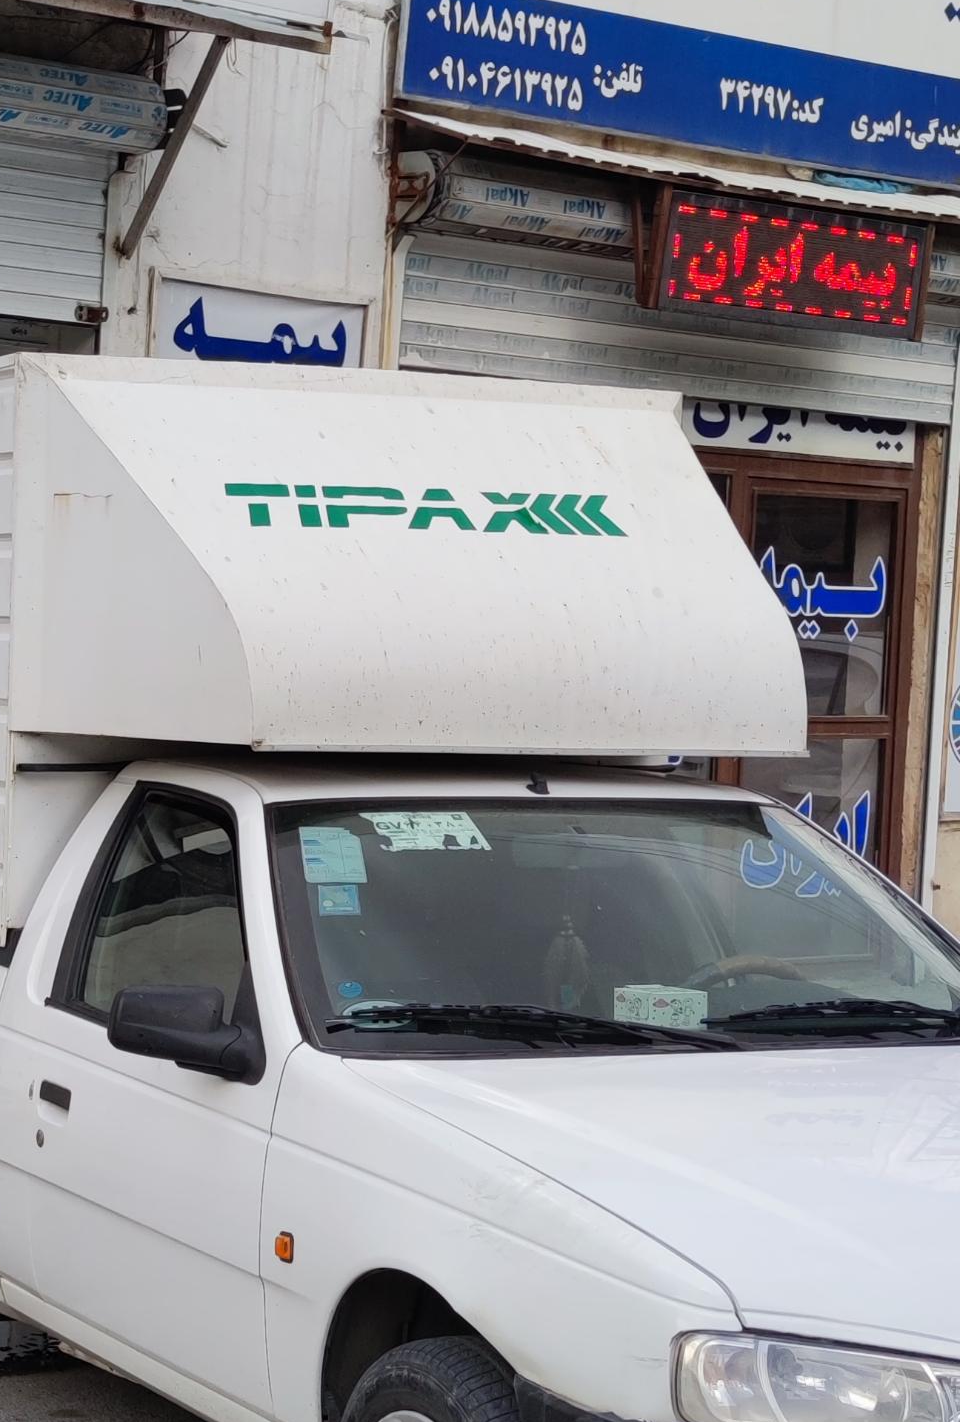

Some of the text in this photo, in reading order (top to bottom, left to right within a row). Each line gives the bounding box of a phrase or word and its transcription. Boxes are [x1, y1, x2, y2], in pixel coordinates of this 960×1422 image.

[428, 55, 644, 112] تلفن: ۰۹۱۰۴۶۱۳۹۲۵
[42, 89, 94, 113] ALTEC
[78, 121, 133, 139] ALTEC
[850, 110, 902, 143] امیری
[485, 185, 606, 219] Akpal Akpal
[407, 256, 432, 275] pal
[688, 225, 897, 309] بیمه ایران
[405, 278, 439, 296] kpal
[224, 482, 629, 538] TIPAX
[760, 546, 887, 642] بیم
